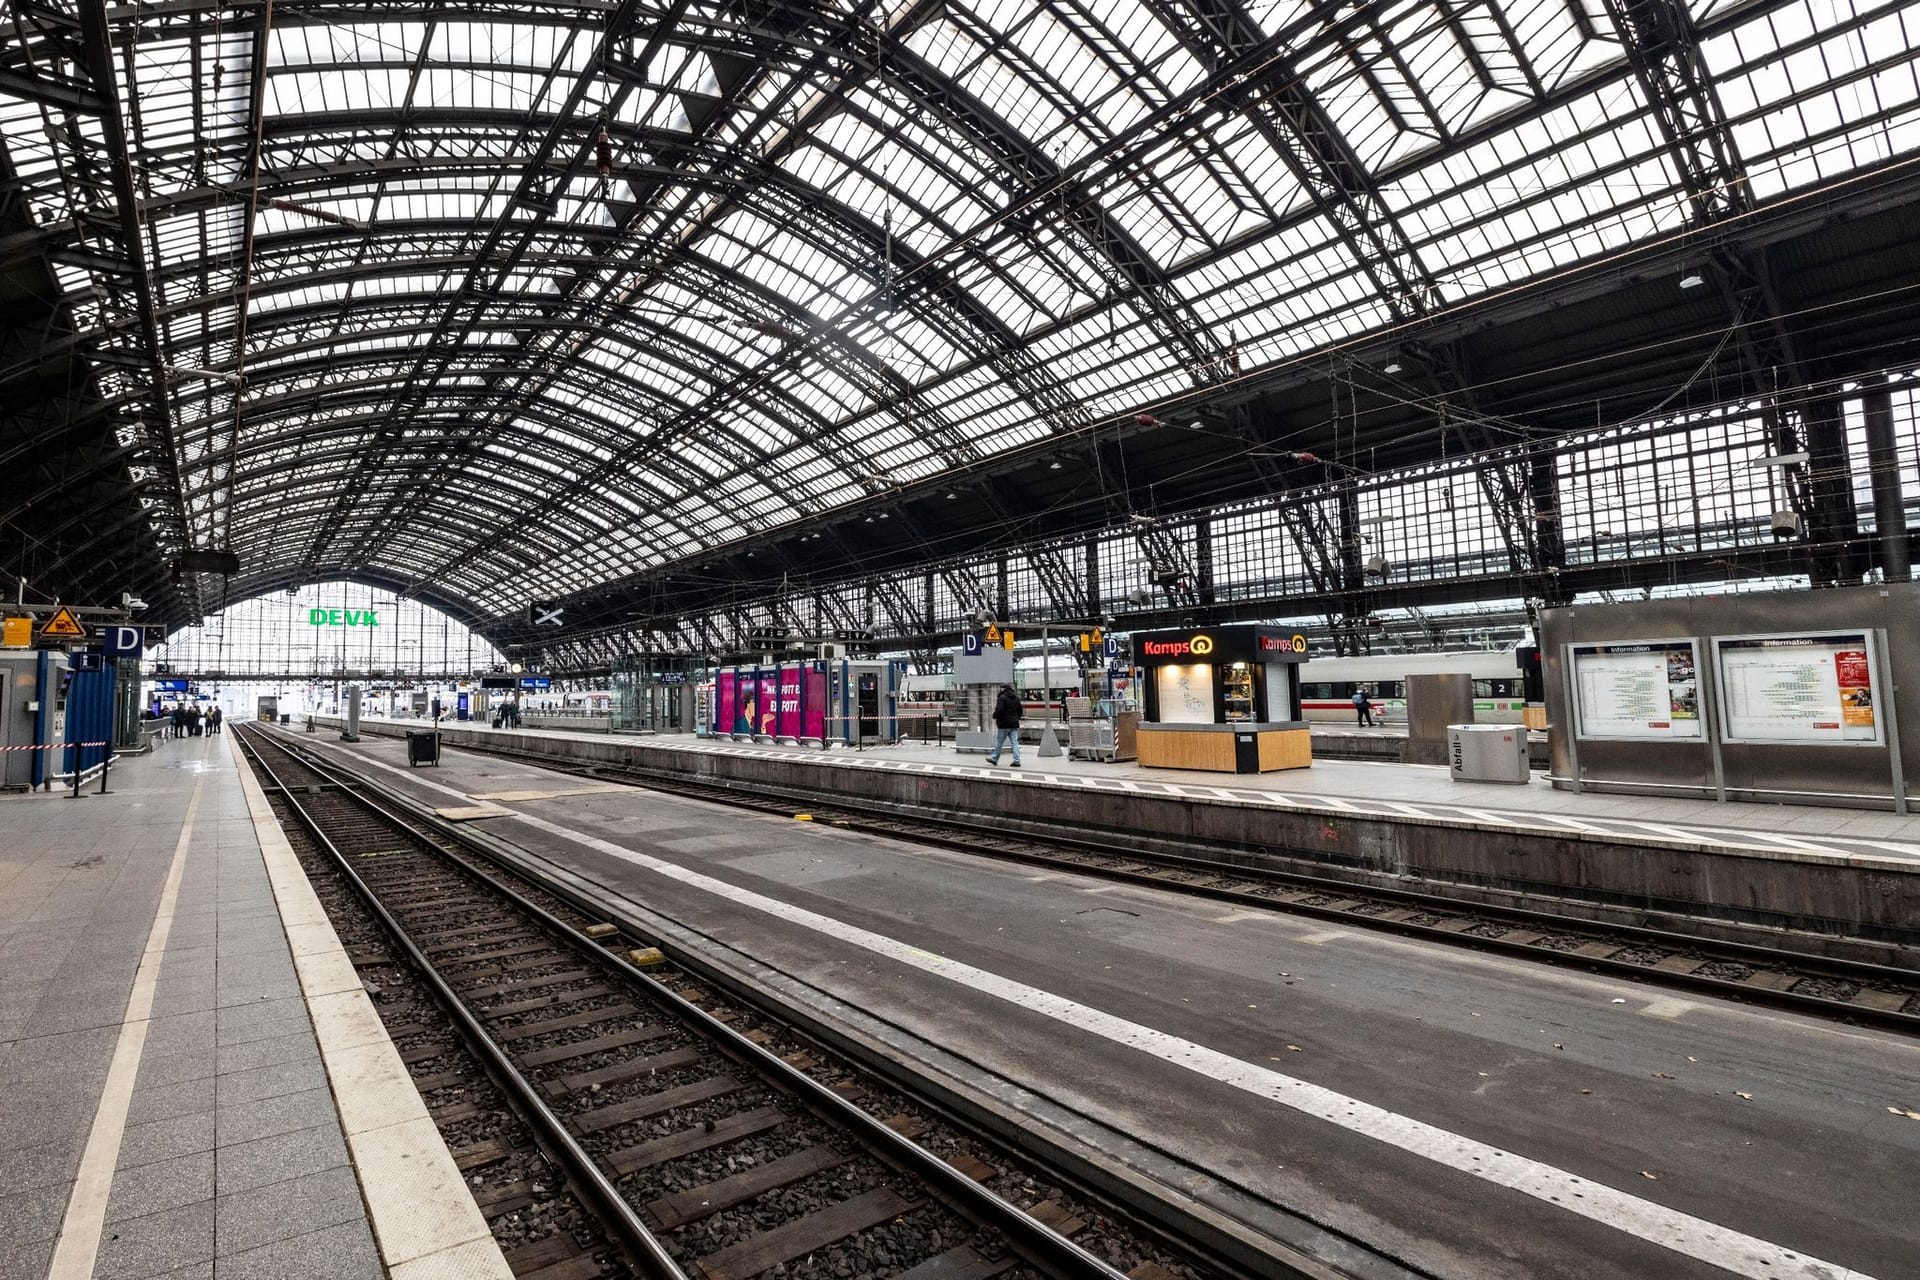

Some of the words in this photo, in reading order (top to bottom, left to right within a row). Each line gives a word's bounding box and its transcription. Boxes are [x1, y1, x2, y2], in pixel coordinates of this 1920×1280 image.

[310, 609, 379, 627] DEVK
[117, 627, 139, 650] D
[967, 634, 976, 651] D
[1108, 638, 1117, 653] D
[1261, 636, 1291, 652] Kamps
[1764, 638, 1813, 646] Information
[1144, 641, 1190, 656] Kamps
[161, 664, 168, 672] 3
[1498, 684, 1505, 693] 2
[781, 700, 799, 713] FOTT
[1453, 742, 1463, 772] Abfall
